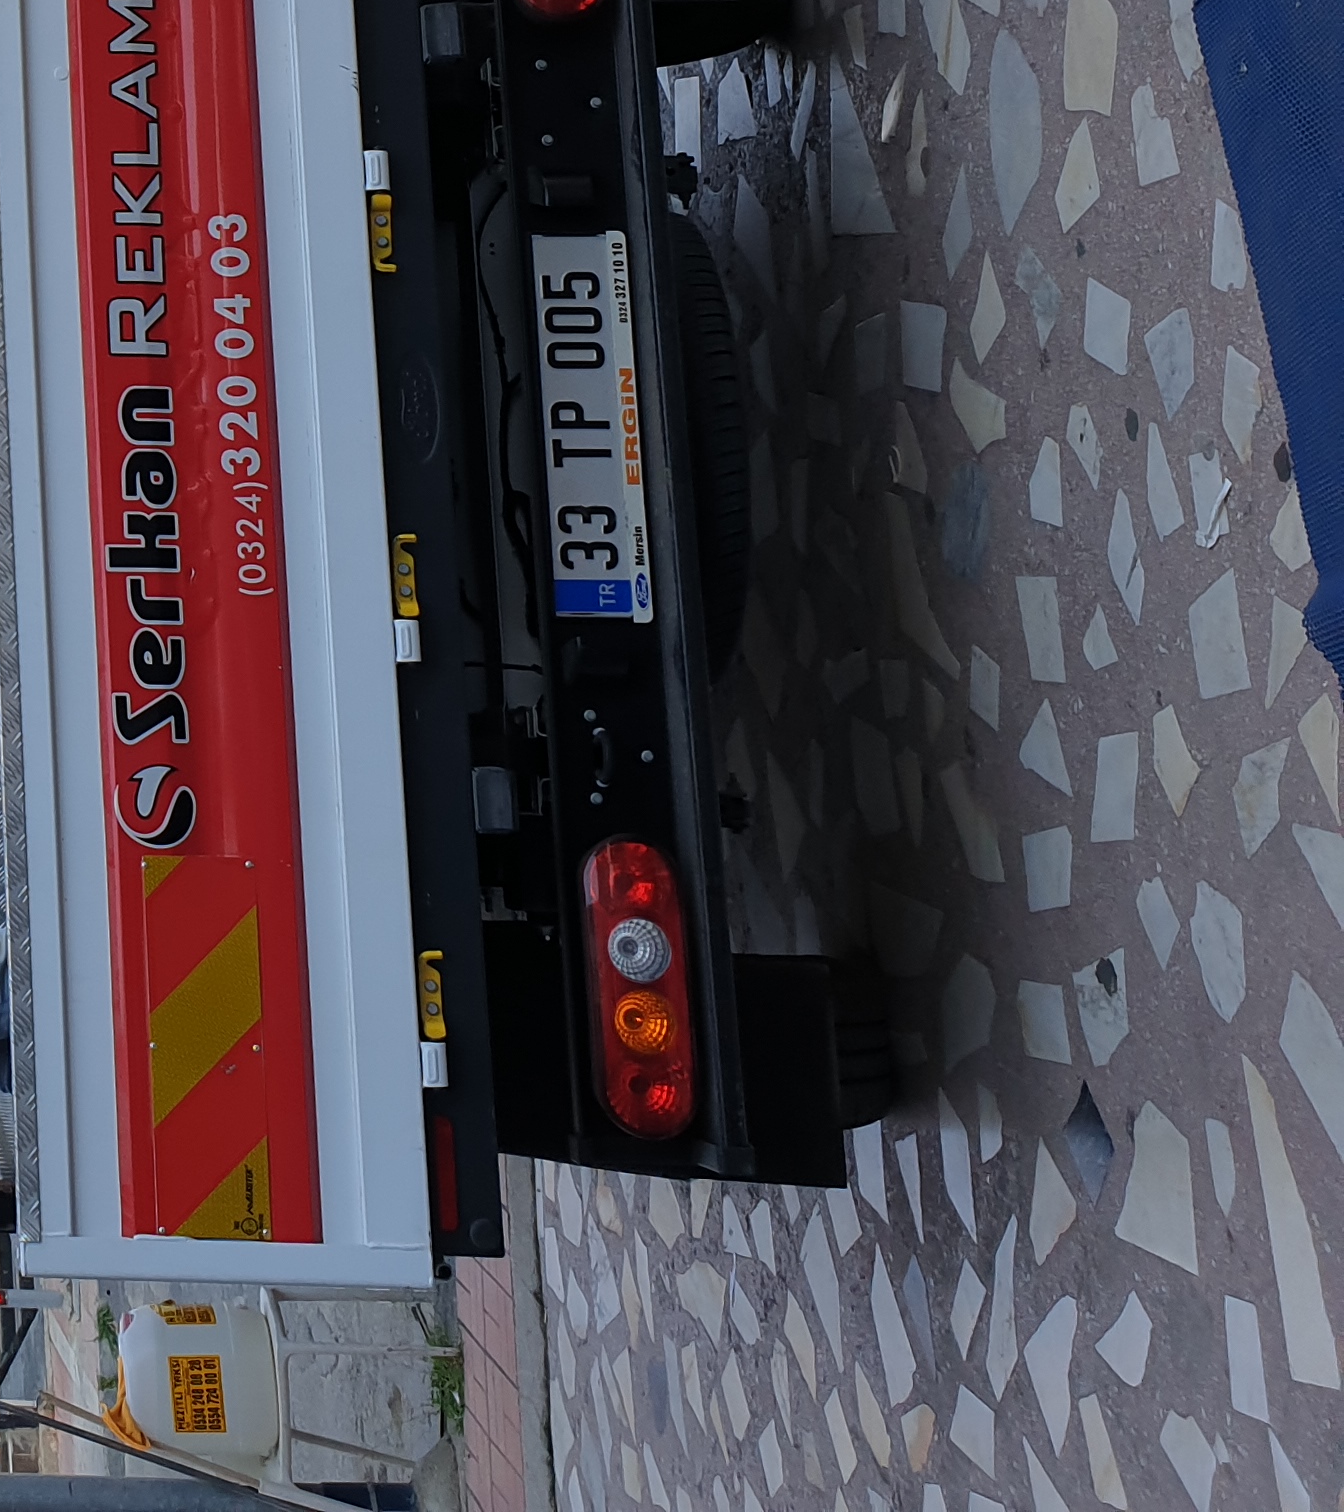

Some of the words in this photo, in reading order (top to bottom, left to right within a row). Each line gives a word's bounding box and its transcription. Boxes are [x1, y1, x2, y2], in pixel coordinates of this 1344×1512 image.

[207, 213, 250, 278] 03
[611, 241, 625, 257] 10
[612, 259, 626, 274] 10
[541, 270, 606, 370] 005
[614, 275, 628, 300] 327
[211, 294, 253, 359] 04
[550, 400, 613, 469] TP
[104, 385, 191, 744] Serkan
[557, 504, 620, 571] 33
[632, 525, 646, 566] Mersin
[598, 583, 618, 607] TR
